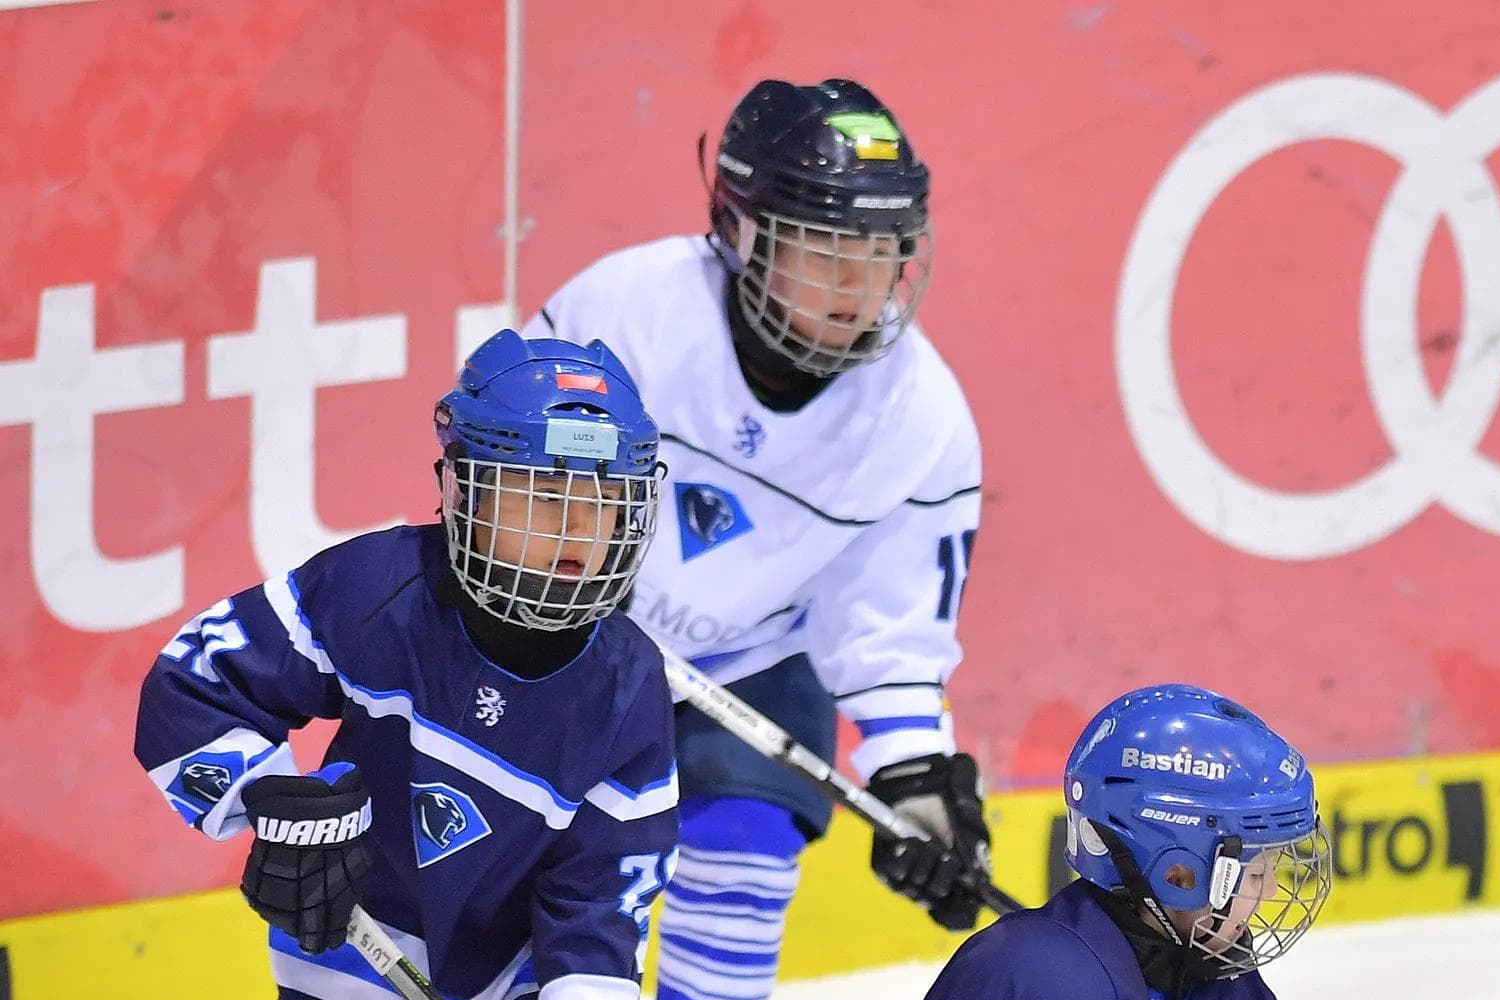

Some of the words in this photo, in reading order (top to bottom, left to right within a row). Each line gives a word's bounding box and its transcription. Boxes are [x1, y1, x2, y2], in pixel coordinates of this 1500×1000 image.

[936, 529, 977, 620] 1
[1121, 747, 1225, 780] Bastian
[1140, 808, 1200, 827] BAUER
